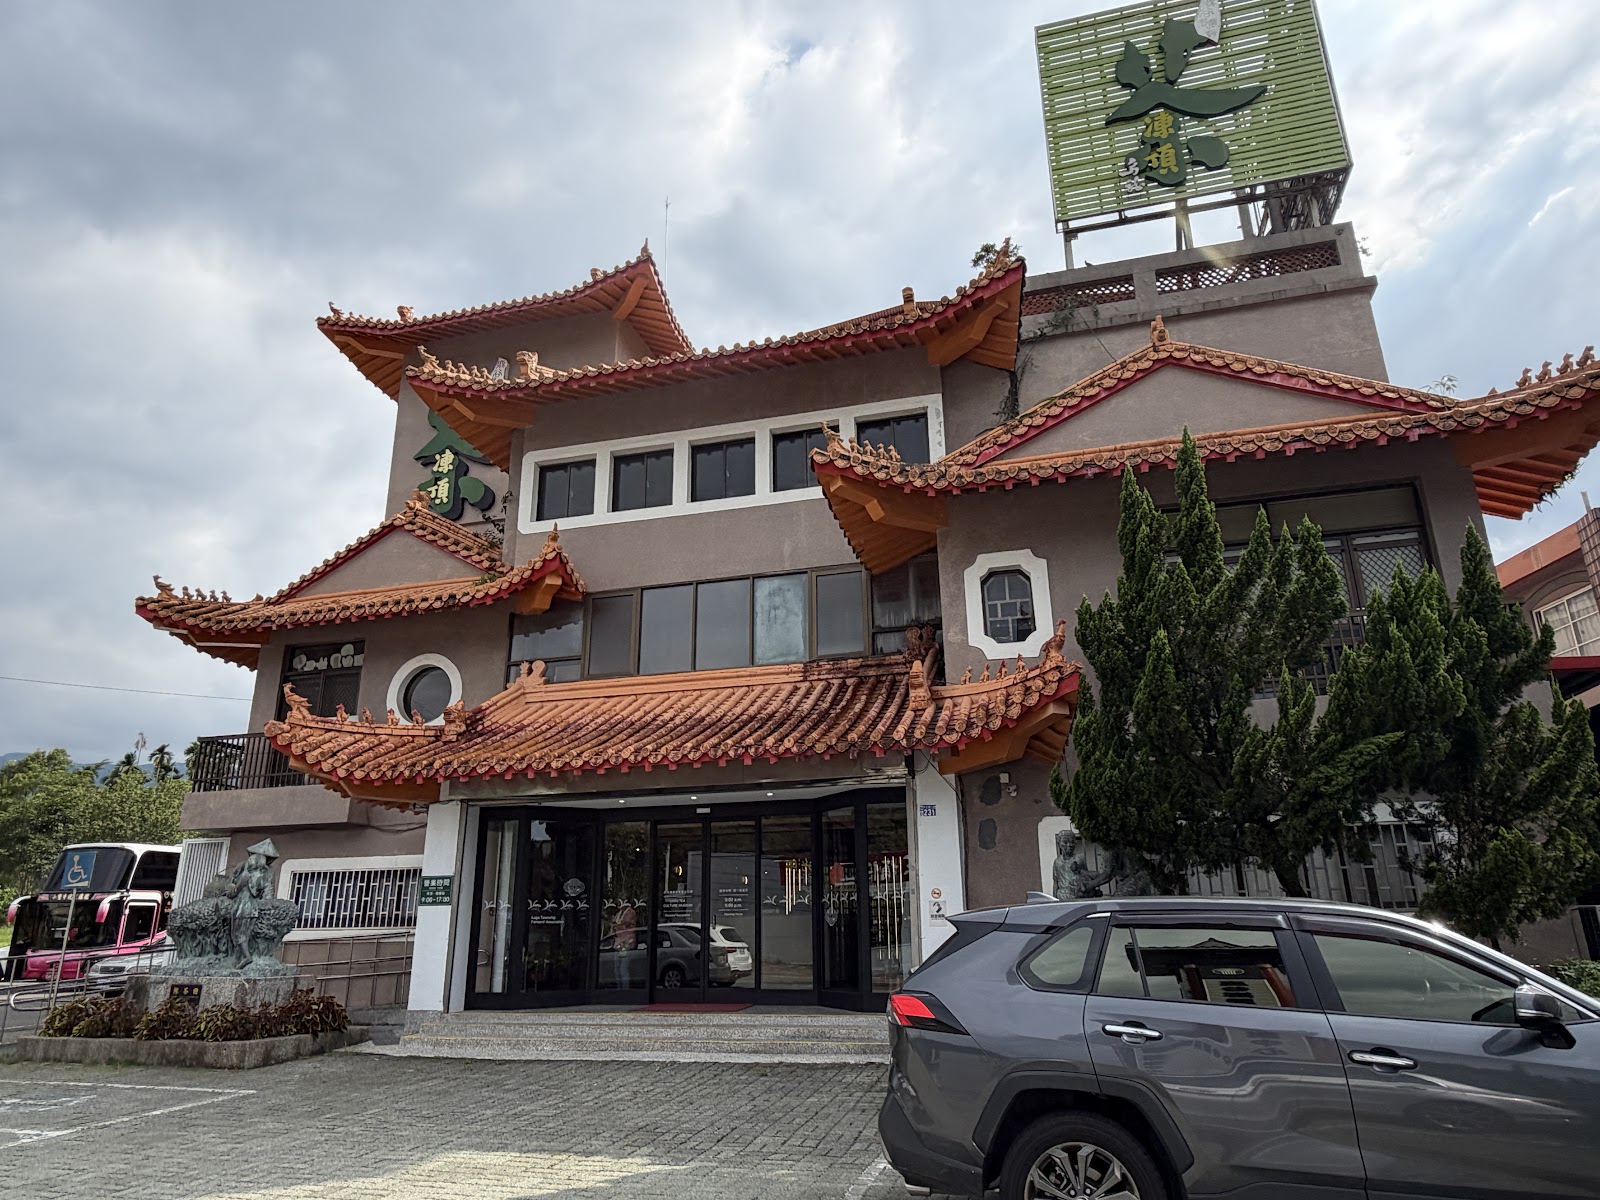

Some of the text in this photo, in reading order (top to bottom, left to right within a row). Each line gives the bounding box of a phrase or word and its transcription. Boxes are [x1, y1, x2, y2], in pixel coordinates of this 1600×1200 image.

[1144, 111, 1179, 174] 凍頂
[427, 448, 455, 504] 凍頂
[923, 808, 935, 816] 231
